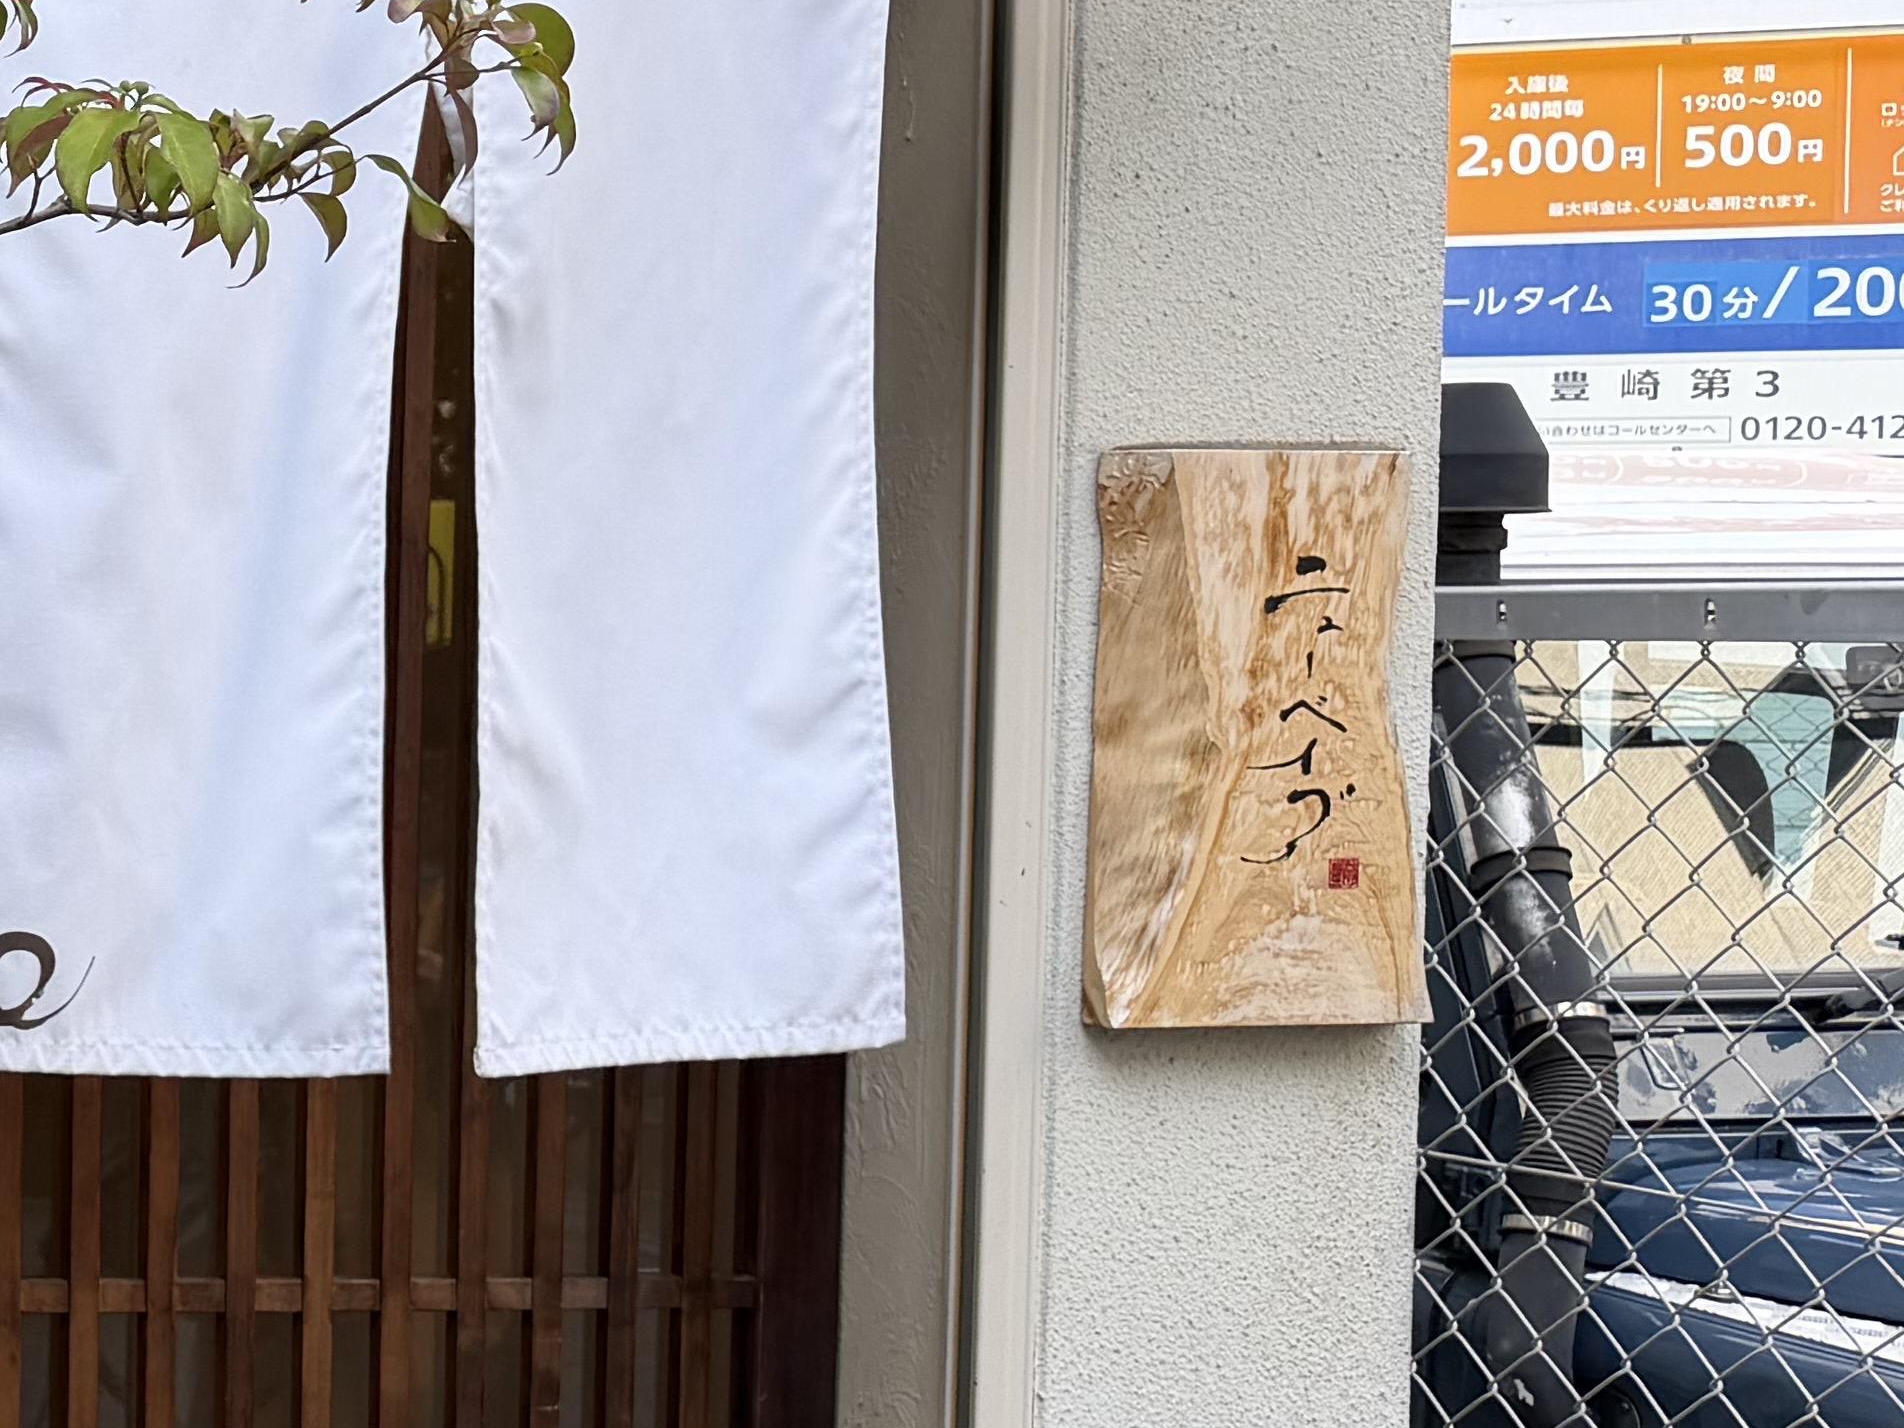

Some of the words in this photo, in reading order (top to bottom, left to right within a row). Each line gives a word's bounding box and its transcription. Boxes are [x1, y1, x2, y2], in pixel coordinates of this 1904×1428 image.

[1456, 129, 1646, 178] 2,000円
[1685, 121, 1824, 169] 500円
[1741, 414, 1904, 441] 0120-412
